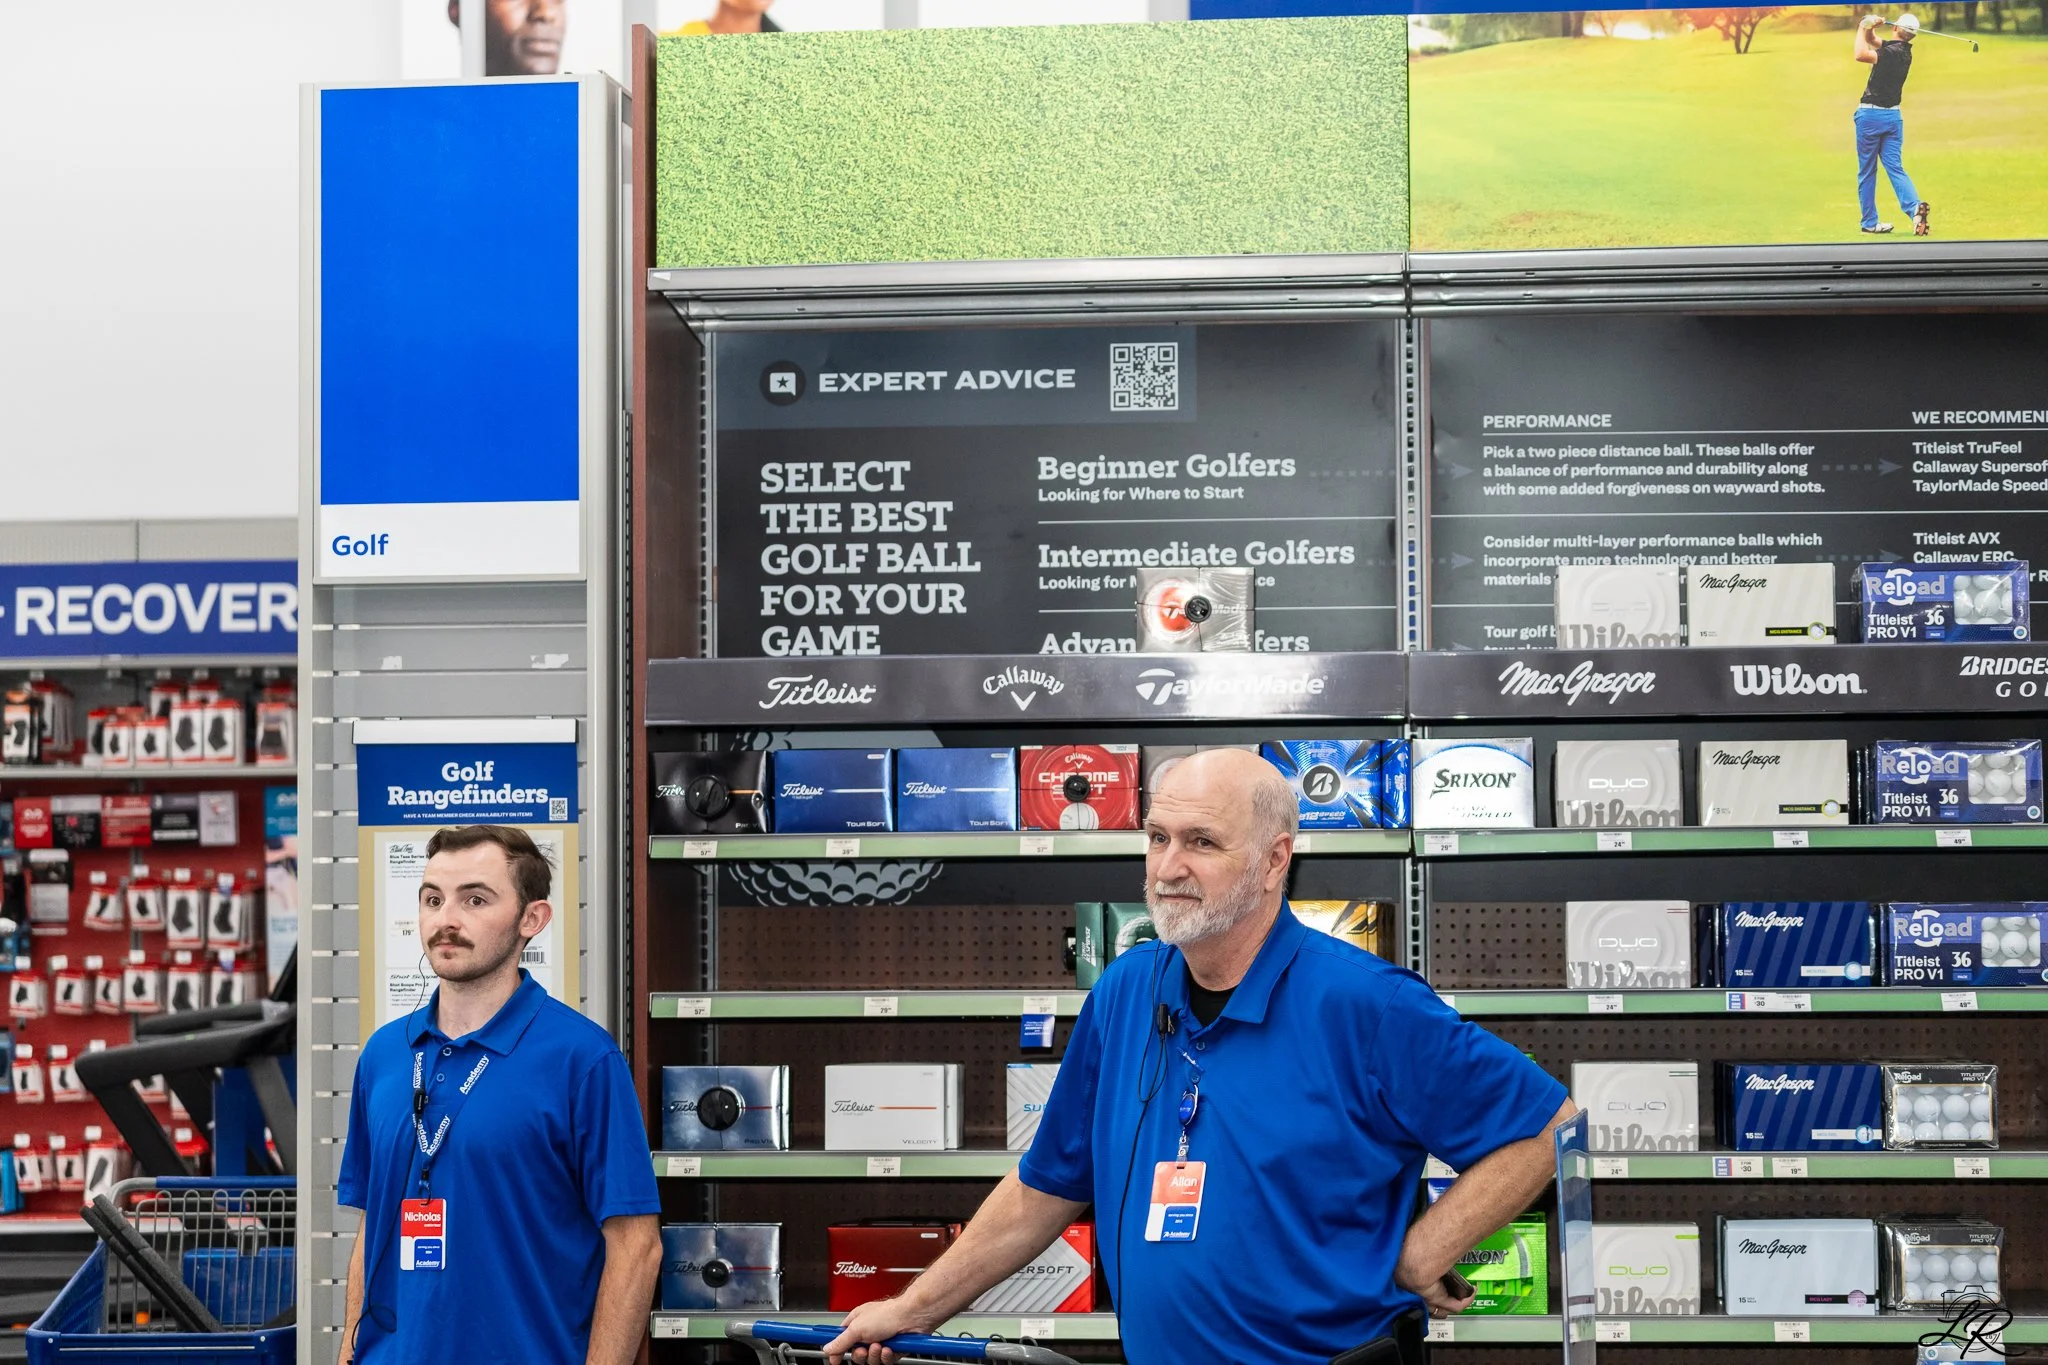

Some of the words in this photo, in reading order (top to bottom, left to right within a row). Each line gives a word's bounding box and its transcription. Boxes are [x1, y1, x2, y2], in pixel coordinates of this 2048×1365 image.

[819, 371, 947, 392] EXPERT
[954, 368, 1076, 390] ADVICE
[1483, 414, 1612, 429] PERFORMANCE
[1912, 411, 1940, 424] WE
[1483, 445, 1514, 459] Pick
[1517, 448, 1526, 458] a
[1527, 447, 1556, 458] two
[1558, 445, 1597, 461] piece
[1599, 444, 1661, 458] distance
[1663, 444, 1693, 456] ball.
[1696, 443, 1739, 456] These
[1742, 443, 1777, 456] balls
[1779, 443, 1815, 456] offer
[1912, 441, 1964, 454] Titleist
[1966, 440, 2022, 454] TruFeel
[760, 460, 911, 493] SELECT
[1038, 454, 1179, 485] Beginner
[1186, 452, 1297, 478] Golfers
[1483, 466, 1492, 477] a
[1494, 464, 1551, 477] balance
[1553, 463, 1568, 477] of
[1571, 463, 1664, 480] performance
[1666, 462, 1693, 475] and
[1695, 462, 1765, 478] durability
[1767, 462, 1808, 477] along
[1912, 460, 1979, 475] Callaway
[1981, 460, 2048, 475] Supersof
[1038, 487, 1100, 503] Looking
[1102, 487, 1126, 501] for
[1128, 486, 1180, 500] Where
[1184, 486, 1201, 500] to
[1203, 485, 1244, 500] Start
[1483, 482, 1516, 496] with
[1518, 485, 1557, 496] some
[1560, 482, 1604, 495] added
[1606, 481, 1690, 497] forgiveness
[1692, 484, 1711, 495] on
[1713, 481, 1779, 497] wayward
[1781, 480, 1825, 493] shots.
[1912, 479, 2000, 494] TaylorMade
[760, 502, 842, 534] THE
[851, 500, 953, 533] BEST
[332, 533, 389, 556] Golf
[1483, 534, 1550, 548] Consider
[1553, 534, 1636, 551] multi-layer
[1639, 533, 1735, 550] performance
[1738, 533, 1774, 547] balls
[1776, 532, 1822, 546] which
[1913, 532, 1965, 545] Titleist
[1967, 531, 2001, 545] AVX
[760, 543, 869, 575] GOLF
[877, 541, 981, 573] BALL
[1038, 541, 1237, 568] Intermediate
[1244, 540, 1355, 565] Golfers
[1483, 553, 1569, 569] incorporate
[1573, 555, 1611, 565] more
[1614, 553, 1697, 568] technology
[1700, 553, 1728, 566] and
[1730, 552, 1777, 565] better
[1913, 551, 1980, 563] Callaway
[1039, 575, 1100, 591] Looking
[1103, 575, 1127, 589] for
[1483, 572, 1552, 587] materials
[1699, 573, 1767, 593] MacGregor
[1867, 574, 1945, 597] Reload
[760, 584, 843, 616] FOR
[848, 582, 967, 614] YOUR
[15, 583, 298, 636] RECOVER
[1867, 613, 1914, 626] Titleist
[1924, 609, 1945, 625] 36
[761, 624, 881, 656] GAME
[1254, 630, 1310, 652] fers
[1484, 626, 1522, 639] Tour
[1523, 625, 1547, 642] golf
[1867, 626, 1898, 639] PRO
[1900, 626, 1917, 638] V1
[1039, 631, 1137, 654] Advan
[982, 665, 1065, 696] Callaway
[1135, 668, 1326, 706] TaylorMade
[1498, 660, 1656, 706] MacGregor
[1730, 663, 1865, 696] Wilson
[758, 674, 876, 709] Titleist
[1995, 681, 2048, 698] GO
[1064, 752, 1094, 764] Callaway
[1712, 750, 1781, 770] MacGregor
[1882, 752, 1960, 775] Reload
[441, 761, 494, 782] Golf
[780, 783, 824, 797] Titleist
[903, 782, 947, 796] Titleist
[1589, 778, 1649, 789] DUO
[387, 783, 549, 810] Rangefinders
[1882, 792, 1928, 805] Titleist
[1938, 788, 1959, 805] 36
[1882, 805, 1912, 818] PRO
[1914, 805, 1932, 817] V1
[1735, 911, 1804, 932] MacGregor
[1893, 915, 1973, 938] Reload
[1598, 937, 1658, 948] DUO
[1894, 955, 1941, 968] Titleist
[1951, 951, 1972, 968] 36
[1894, 969, 1925, 981] PRO
[1929, 968, 1944, 980] V1
[460, 1054, 489, 1095] Academy
[1745, 1073, 1815, 1095] MacGregor
[831, 1100, 875, 1113] Titleist
[1607, 1101, 1667, 1111] DUO
[426, 1114, 451, 1156] Academy
[1171, 1175, 1197, 1188] Allan
[404, 1211, 441, 1222] Nicholas
[1739, 1238, 1807, 1259] MacGregor
[415, 1259, 440, 1268] Academy
[832, 1261, 877, 1276] Titleist
[1018, 1265, 1075, 1275] ERSOFT
[1608, 1266, 1668, 1276] DUO
